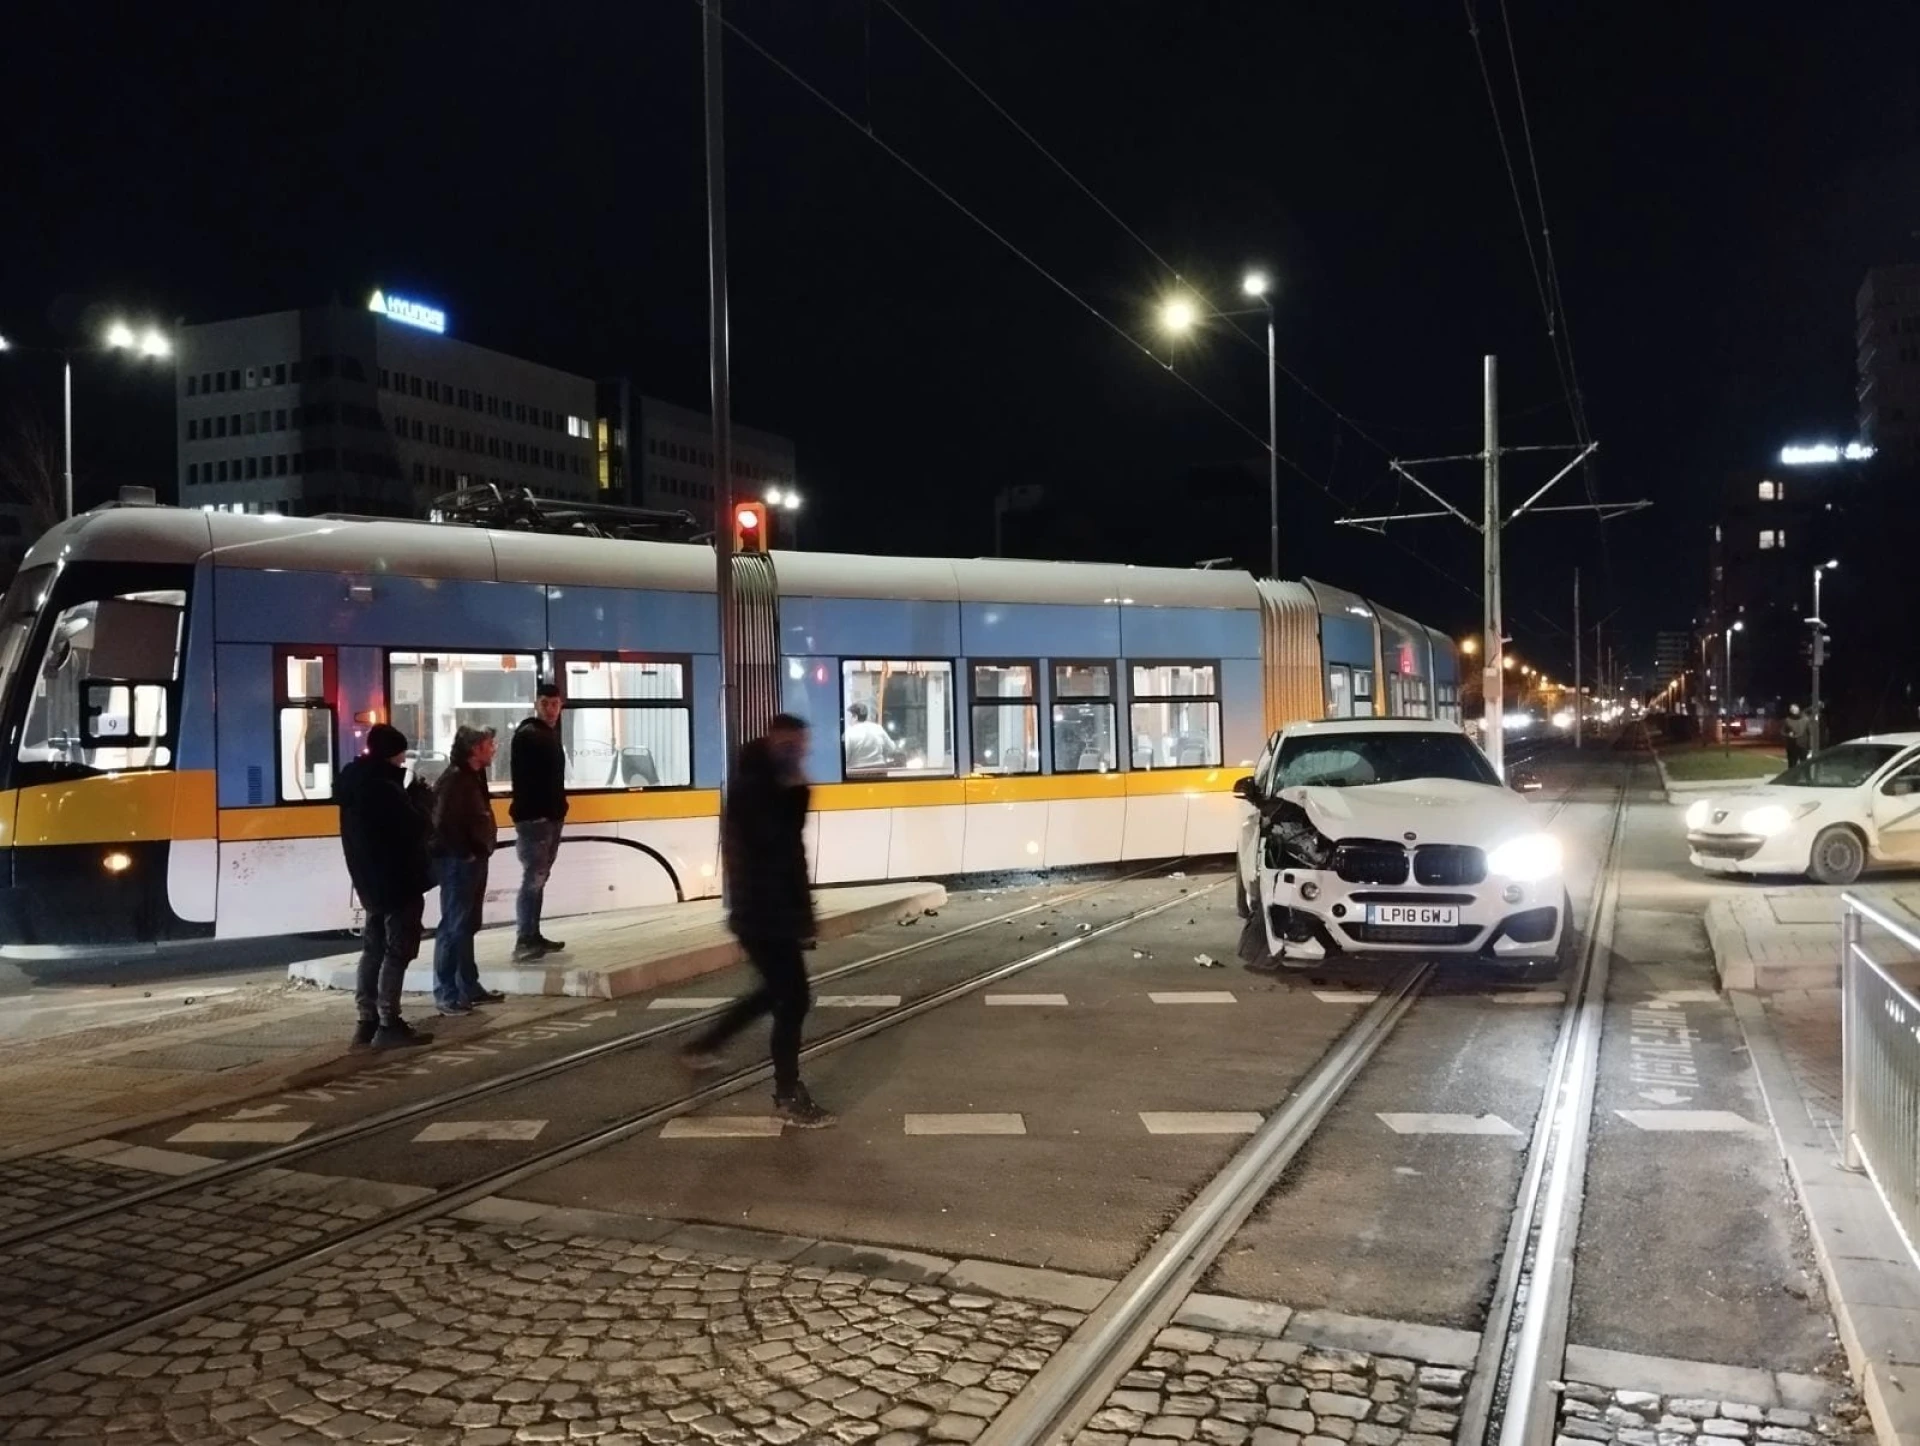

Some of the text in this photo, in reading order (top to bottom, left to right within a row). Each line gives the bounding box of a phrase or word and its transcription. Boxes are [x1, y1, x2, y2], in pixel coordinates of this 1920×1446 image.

[108, 719, 117, 731] 9
[1380, 908, 1452, 923] LP18 GWJ
